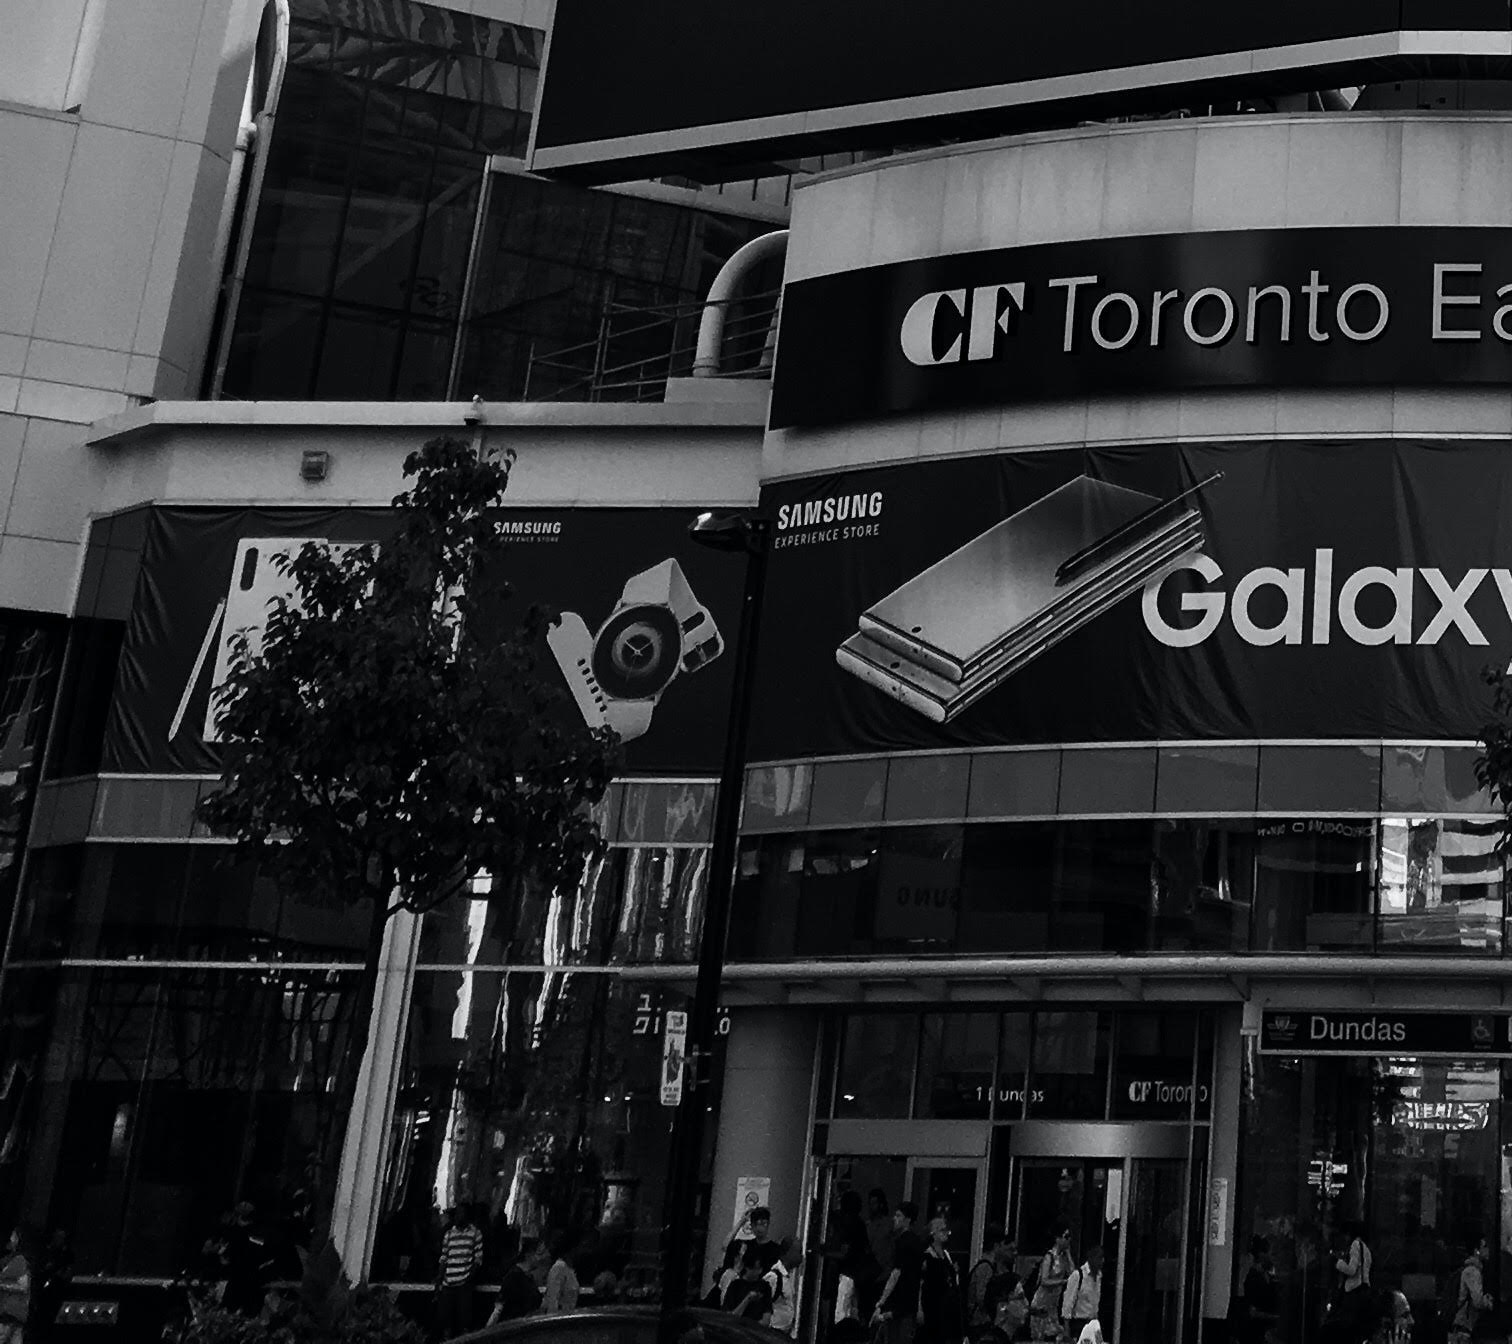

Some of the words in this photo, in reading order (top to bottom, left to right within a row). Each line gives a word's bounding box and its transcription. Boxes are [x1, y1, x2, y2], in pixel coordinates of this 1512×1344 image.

[900, 281, 1025, 366] CF
[1048, 269, 1389, 352] Toronto
[777, 491, 883, 530] SAMSUNG
[493, 521, 562, 535] SAMSUNG
[774, 528, 840, 550] EXPERIENCE
[843, 523, 880, 540] STORE
[1310, 1015, 1407, 1042] Dundas
[1128, 1080, 1152, 1103] CF
[1154, 1080, 1208, 1103] Torono
